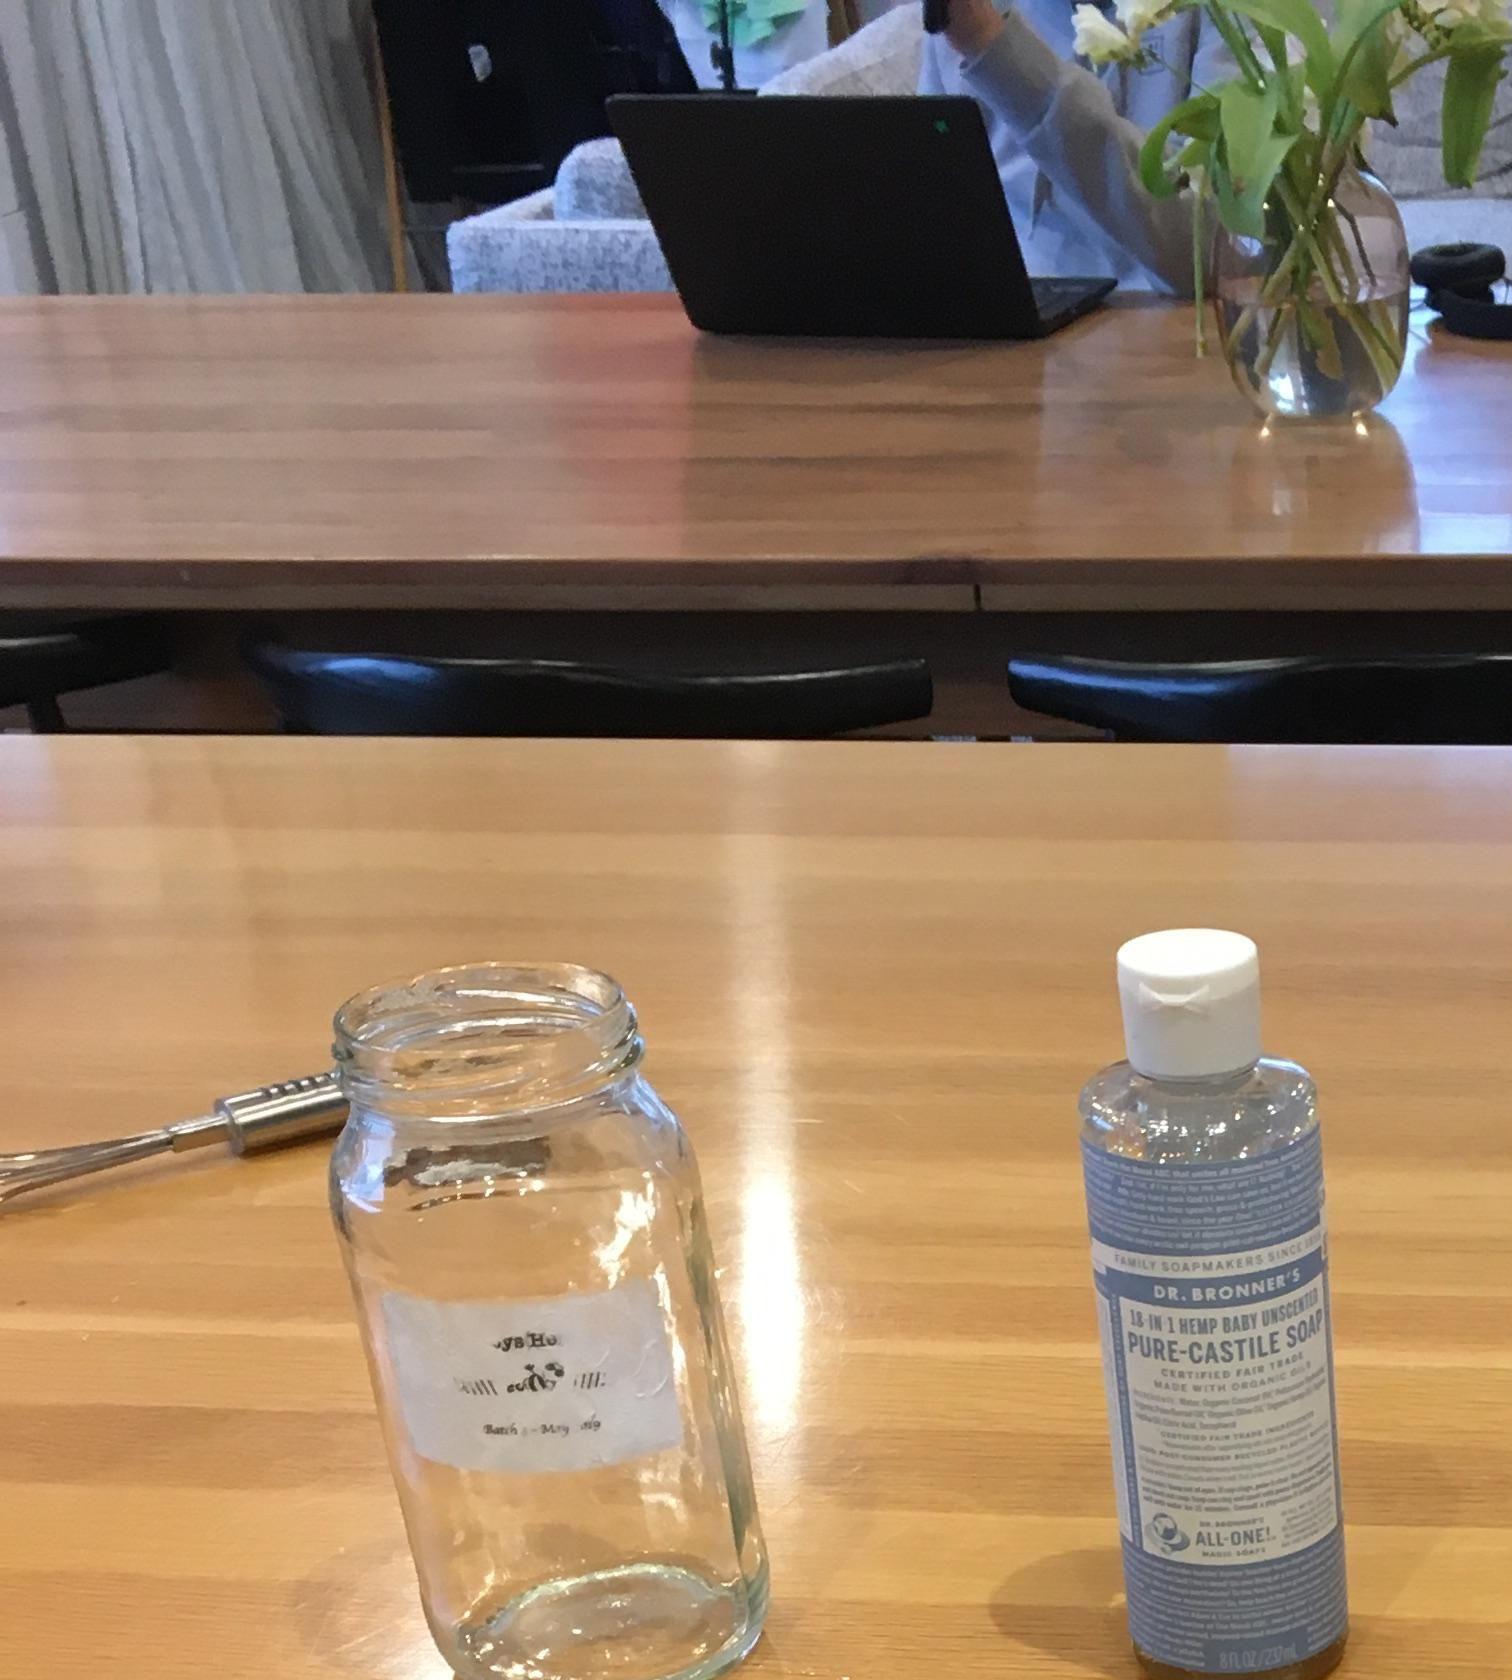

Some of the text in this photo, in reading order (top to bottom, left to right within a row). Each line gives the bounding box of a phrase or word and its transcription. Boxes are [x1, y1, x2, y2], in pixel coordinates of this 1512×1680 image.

[1114, 1241, 1302, 1272] FAMILY SOAPMAKERS SINCE
[1153, 1267, 1300, 1303] DR. BRONNER'S
[1178, 1317, 1218, 1335] HEMP
[1222, 1311, 1258, 1334] BABY
[1261, 1287, 1318, 1328] UNSCENTED
[1128, 1308, 1322, 1364] PURE-CASTILE SOAP
[1160, 1351, 1304, 1379] CERTIFIED FAIR TRADE
[1154, 1379, 1188, 1393] MADE
[1192, 1384, 1226, 1393] WITH
[1231, 1372, 1286, 1391] ORGANIC
[1195, 1526, 1271, 1547] ALL-ONE!
